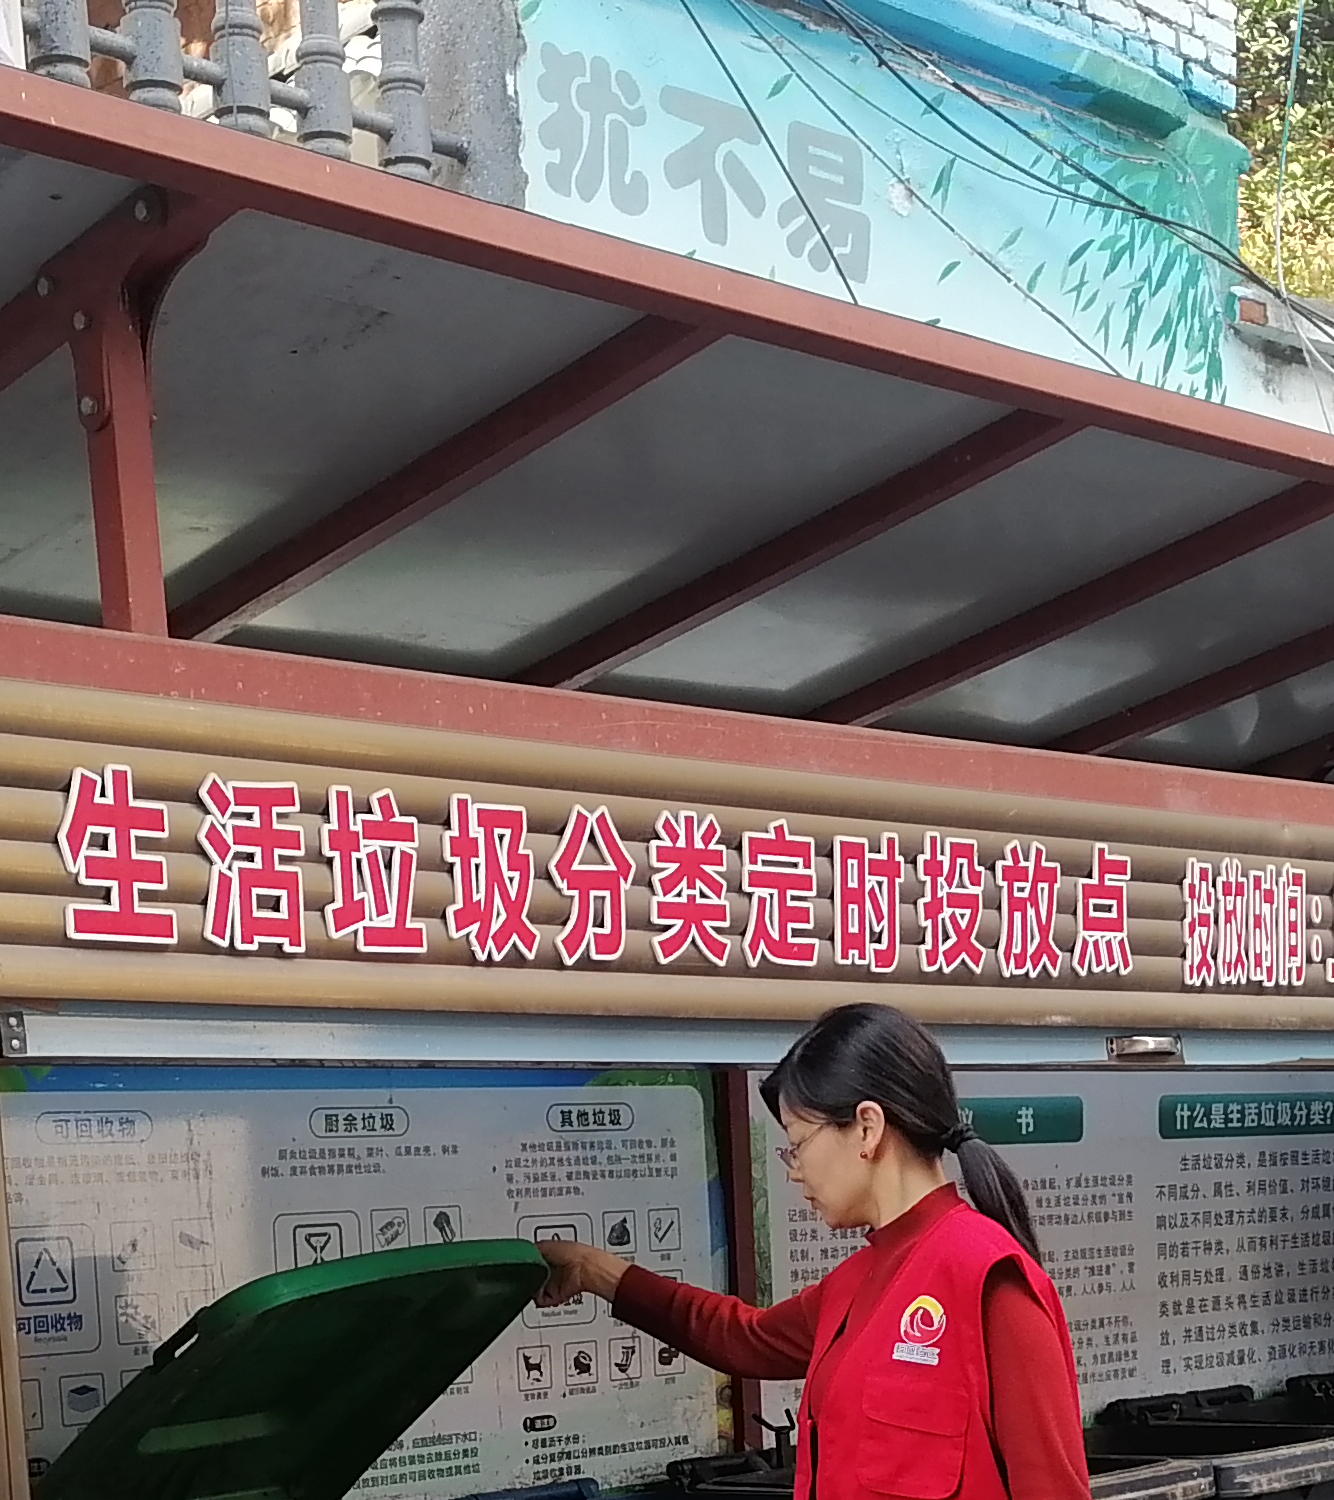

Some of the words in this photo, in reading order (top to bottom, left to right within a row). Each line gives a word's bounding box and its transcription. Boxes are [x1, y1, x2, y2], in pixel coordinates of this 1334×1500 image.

[60, 762, 1135, 979] 生活垃圾分类定时投放点
[52, 1116, 136, 1140] 可回收物
[324, 1112, 396, 1133] 厨余垃圾
[559, 1109, 622, 1128] 其他垃圾
[17, 1312, 84, 1334] 可回收物
